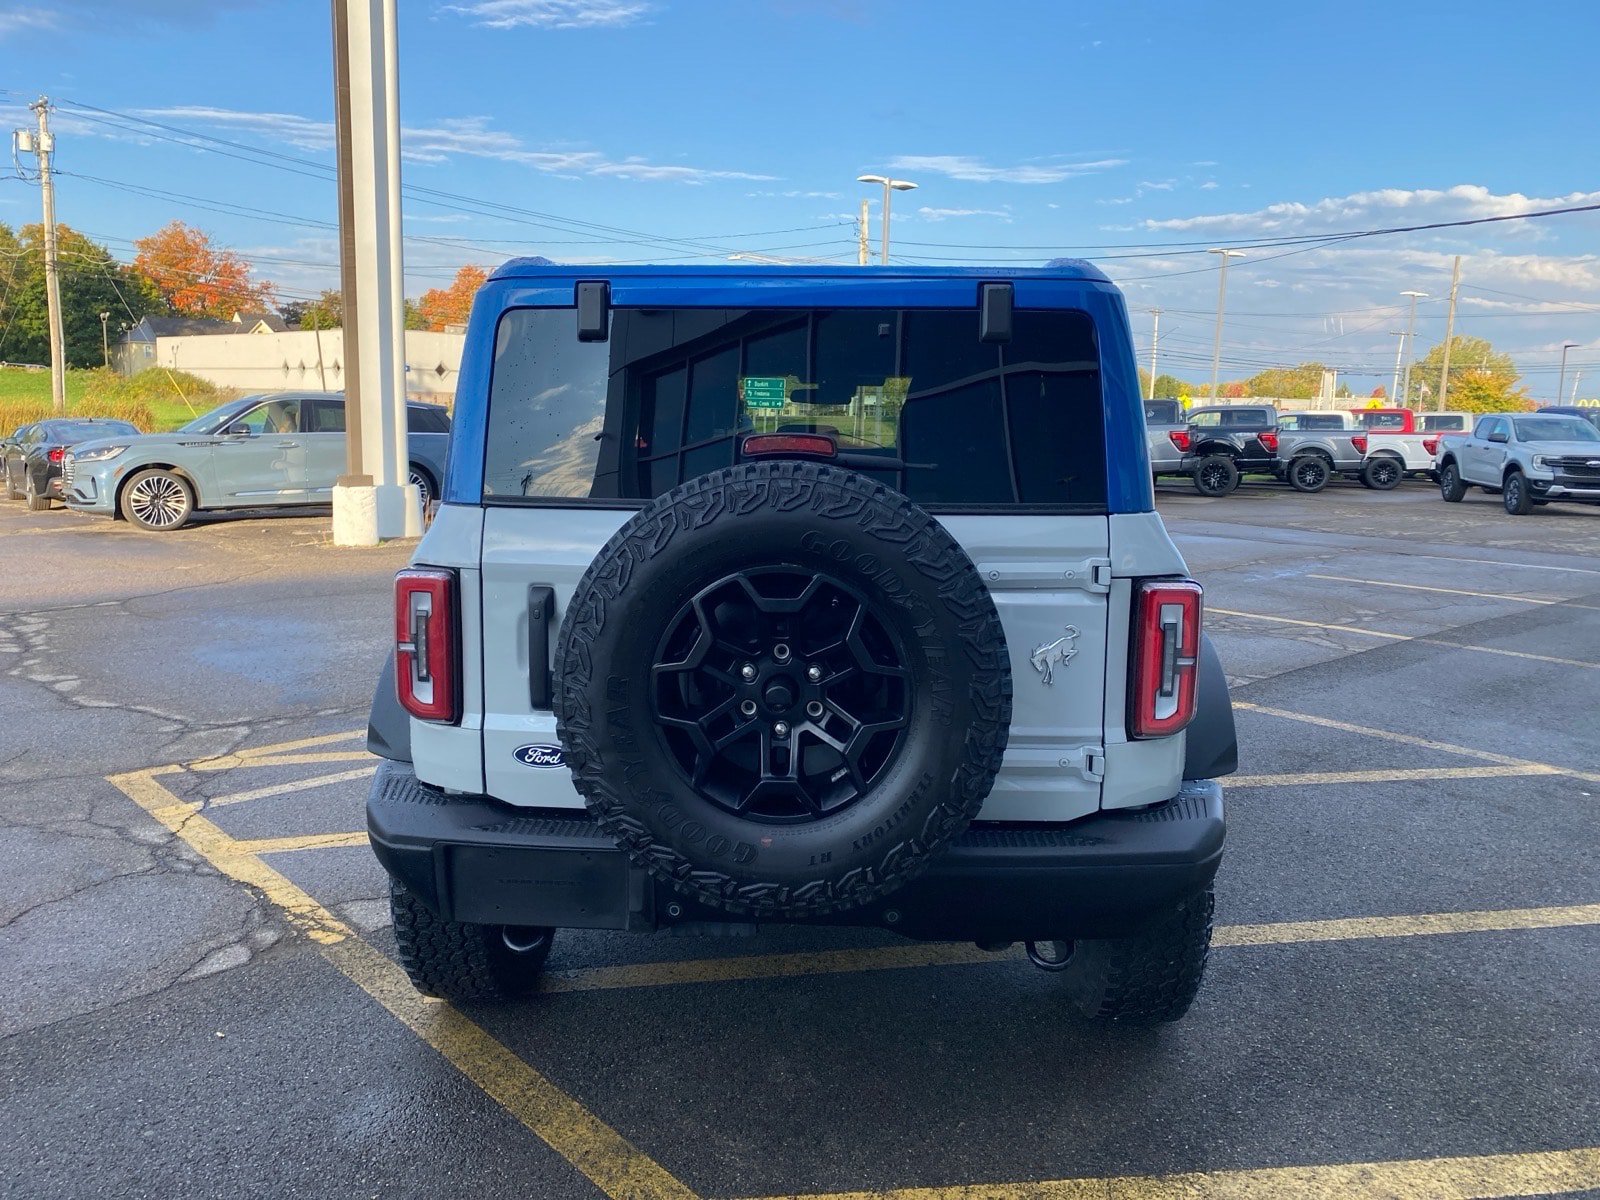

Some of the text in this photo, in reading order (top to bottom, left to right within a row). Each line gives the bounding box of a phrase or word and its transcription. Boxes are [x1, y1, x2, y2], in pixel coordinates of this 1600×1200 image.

[800, 530, 954, 728] GOODYEAR
[524, 747, 562, 763] Ford
[606, 675, 758, 865] GOODYEAR
[852, 771, 934, 852] TERRITORY
[807, 851, 832, 866] RT
